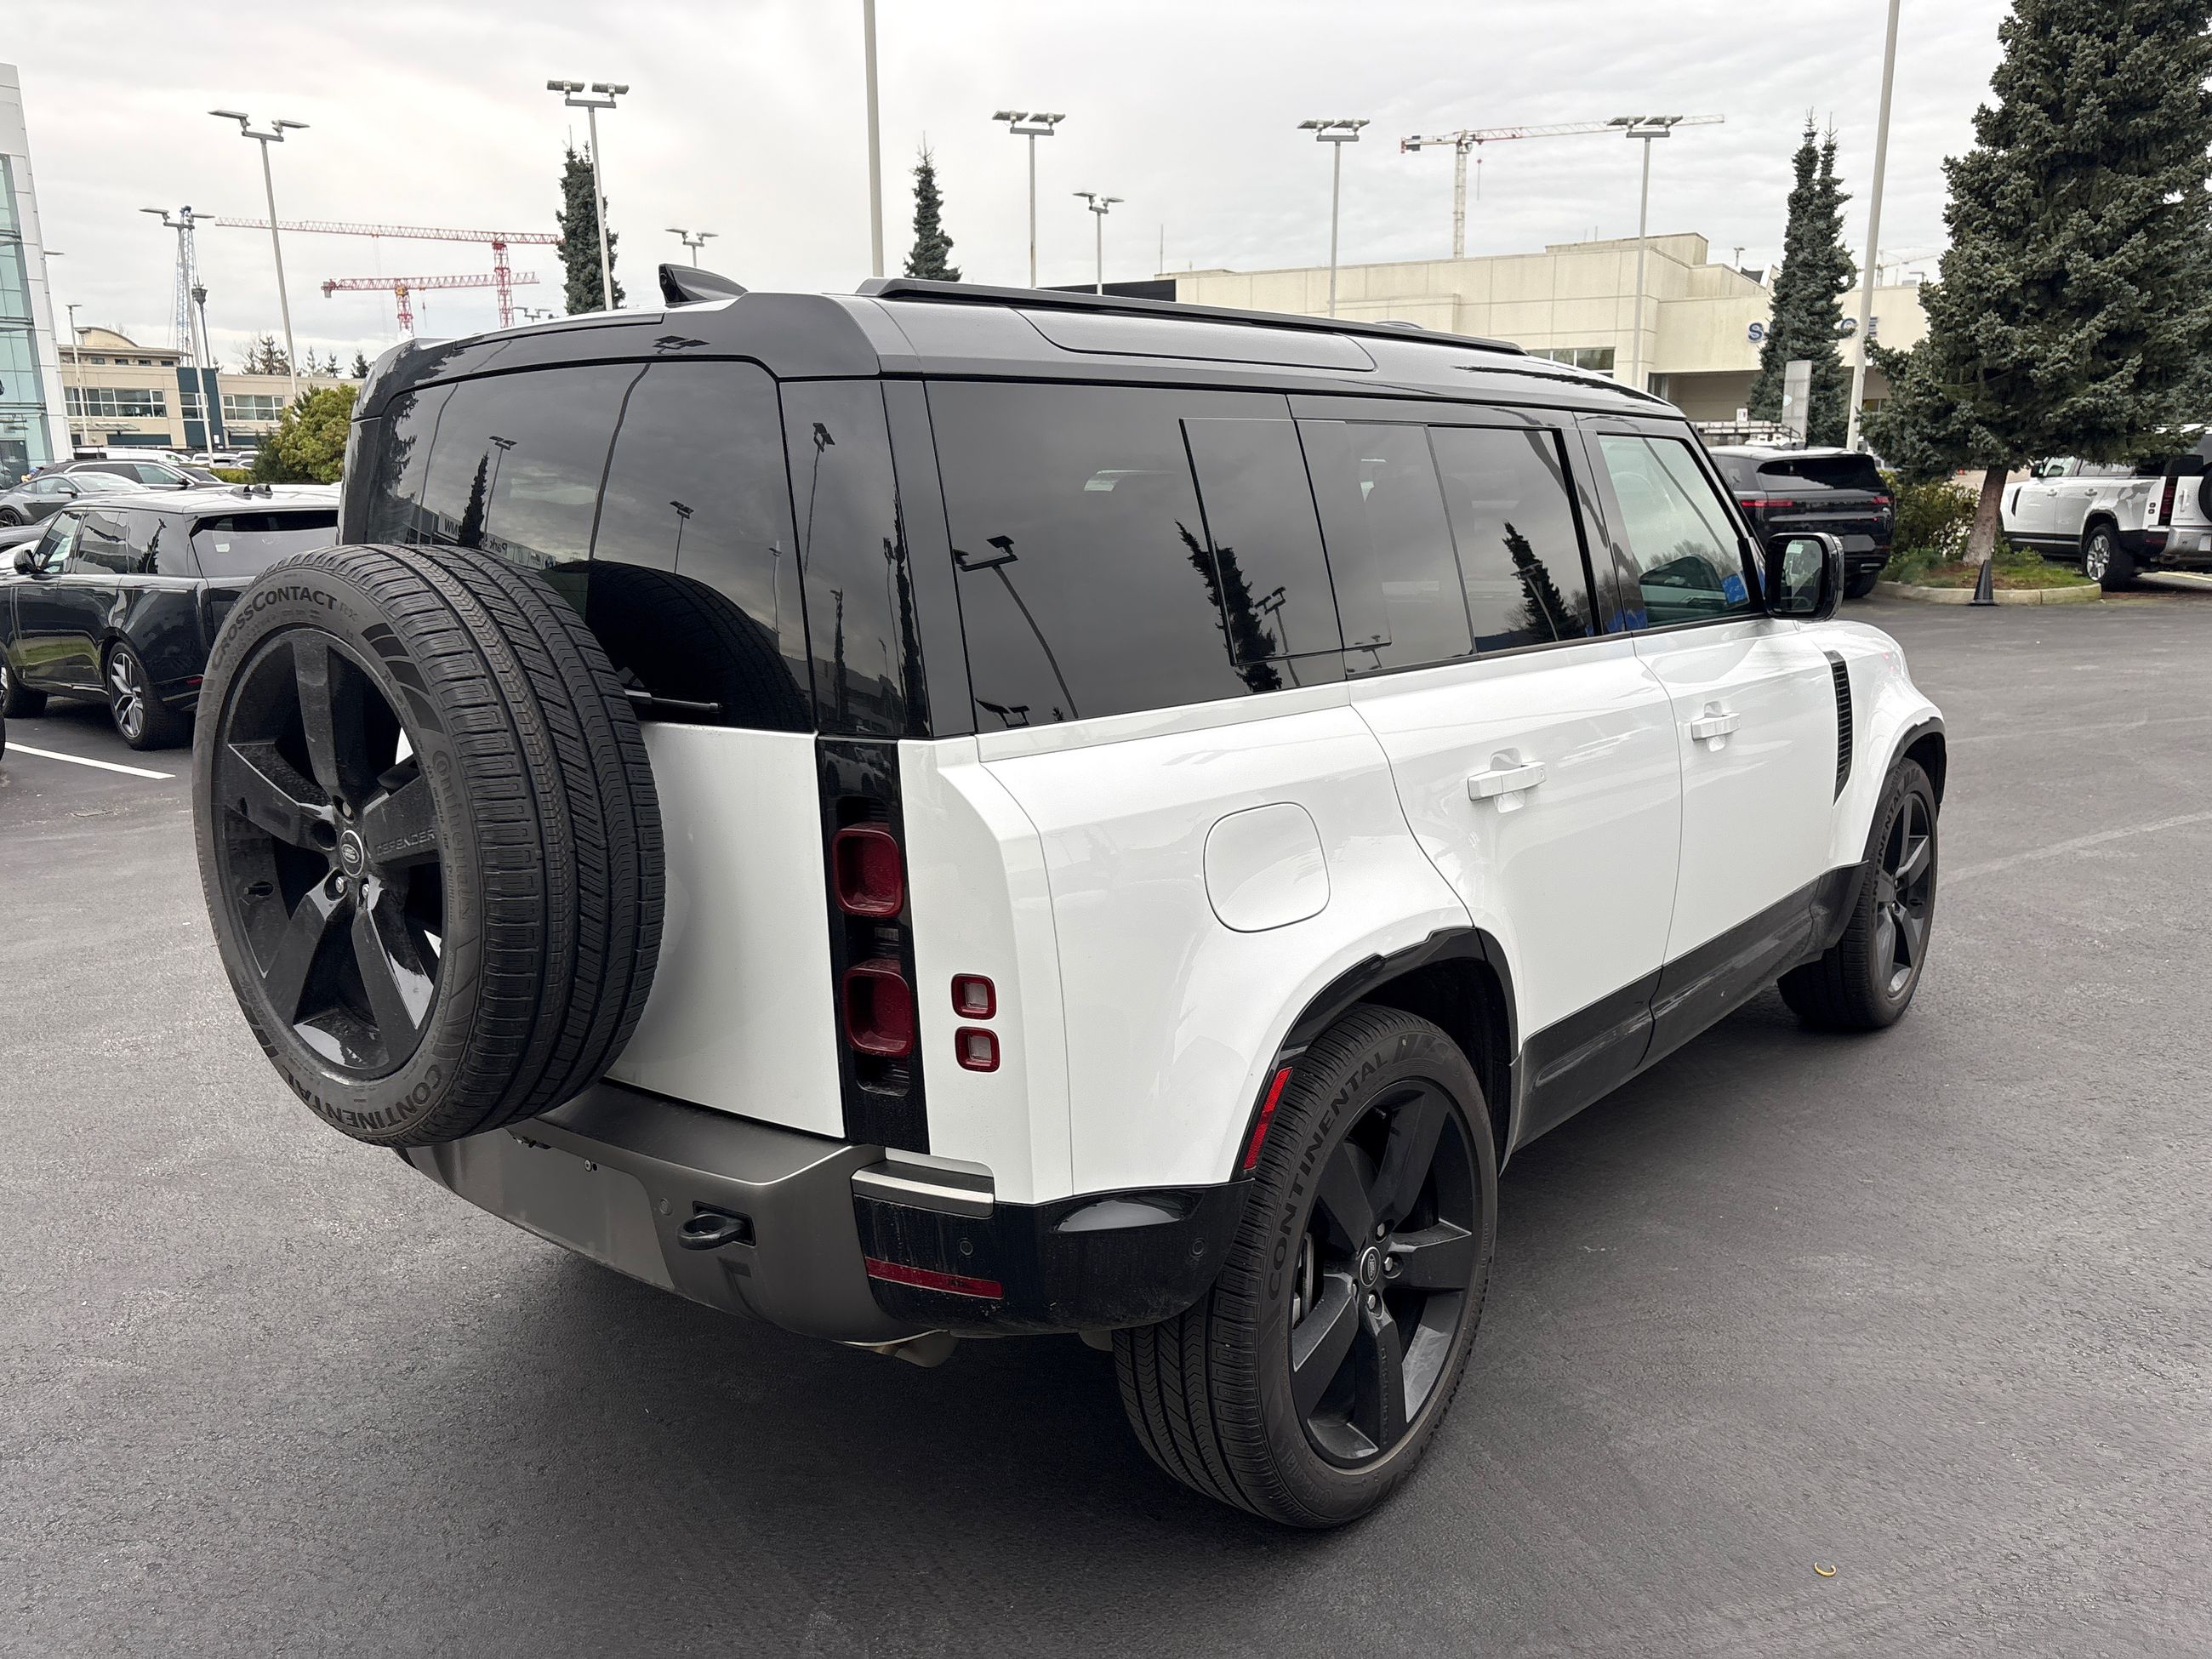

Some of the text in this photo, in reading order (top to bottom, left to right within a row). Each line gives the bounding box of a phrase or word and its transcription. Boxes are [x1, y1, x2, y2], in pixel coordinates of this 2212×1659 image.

[376, 829, 436, 857] DEFENDER
[282, 1064, 442, 1131] CONTINENTAL
[1268, 1052, 1388, 1301] CONTINENTAL
